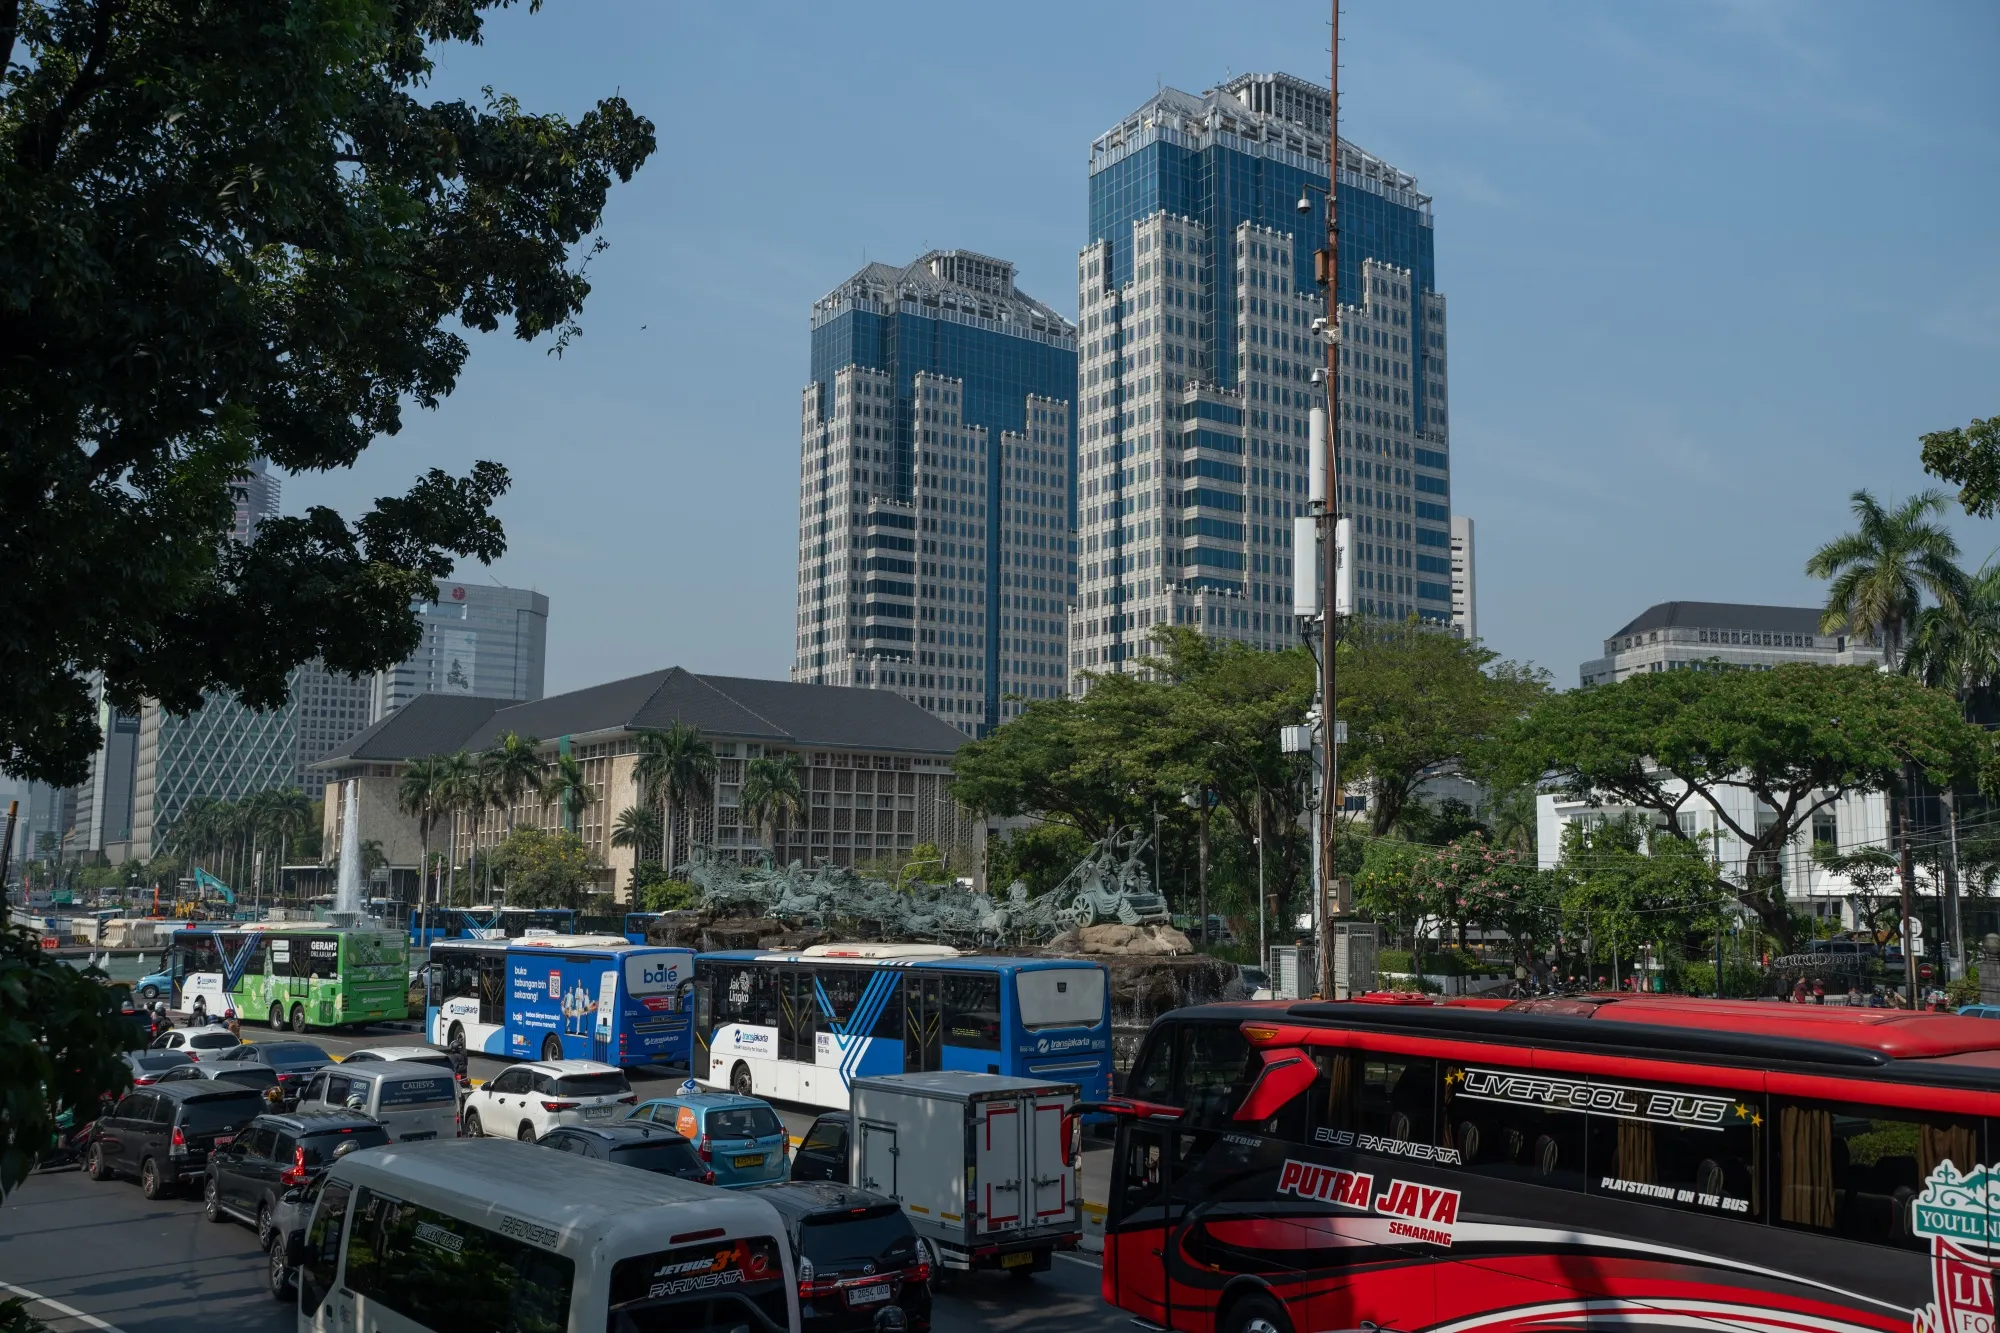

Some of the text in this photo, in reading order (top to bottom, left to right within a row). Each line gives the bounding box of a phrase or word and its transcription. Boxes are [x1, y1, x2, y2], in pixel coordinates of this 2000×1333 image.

[311, 941, 337, 951] GERAH?
[514, 966, 527, 976] buka
[514, 978, 538, 991] tabungan
[728, 977, 740, 990] Jak
[514, 990, 539, 1003] sekarang!
[728, 990, 749, 1005] Lingko
[742, 1031, 769, 1044] transjakarta
[1050, 1038, 1090, 1050] transjakarta
[1464, 1072, 1727, 1123] LIVERPOOL BUS
[1222, 1134, 1262, 1148] JETBUS
[1315, 1127, 1462, 1165] BUS PARIWISATA
[1279, 1161, 1459, 1226] PUTRA JAYA
[1601, 1177, 1749, 1213] PLAYSTATION ON THE BUS
[1920, 1209, 1980, 1235] YOU'LL
[415, 1224, 464, 1251] QUEEN CLASS
[499, 1215, 560, 1248] PARIWISATA
[1388, 1221, 1452, 1246] SEMARANG
[648, 1268, 746, 1299] PARIWISATA
[857, 1288, 874, 1299] 2054
